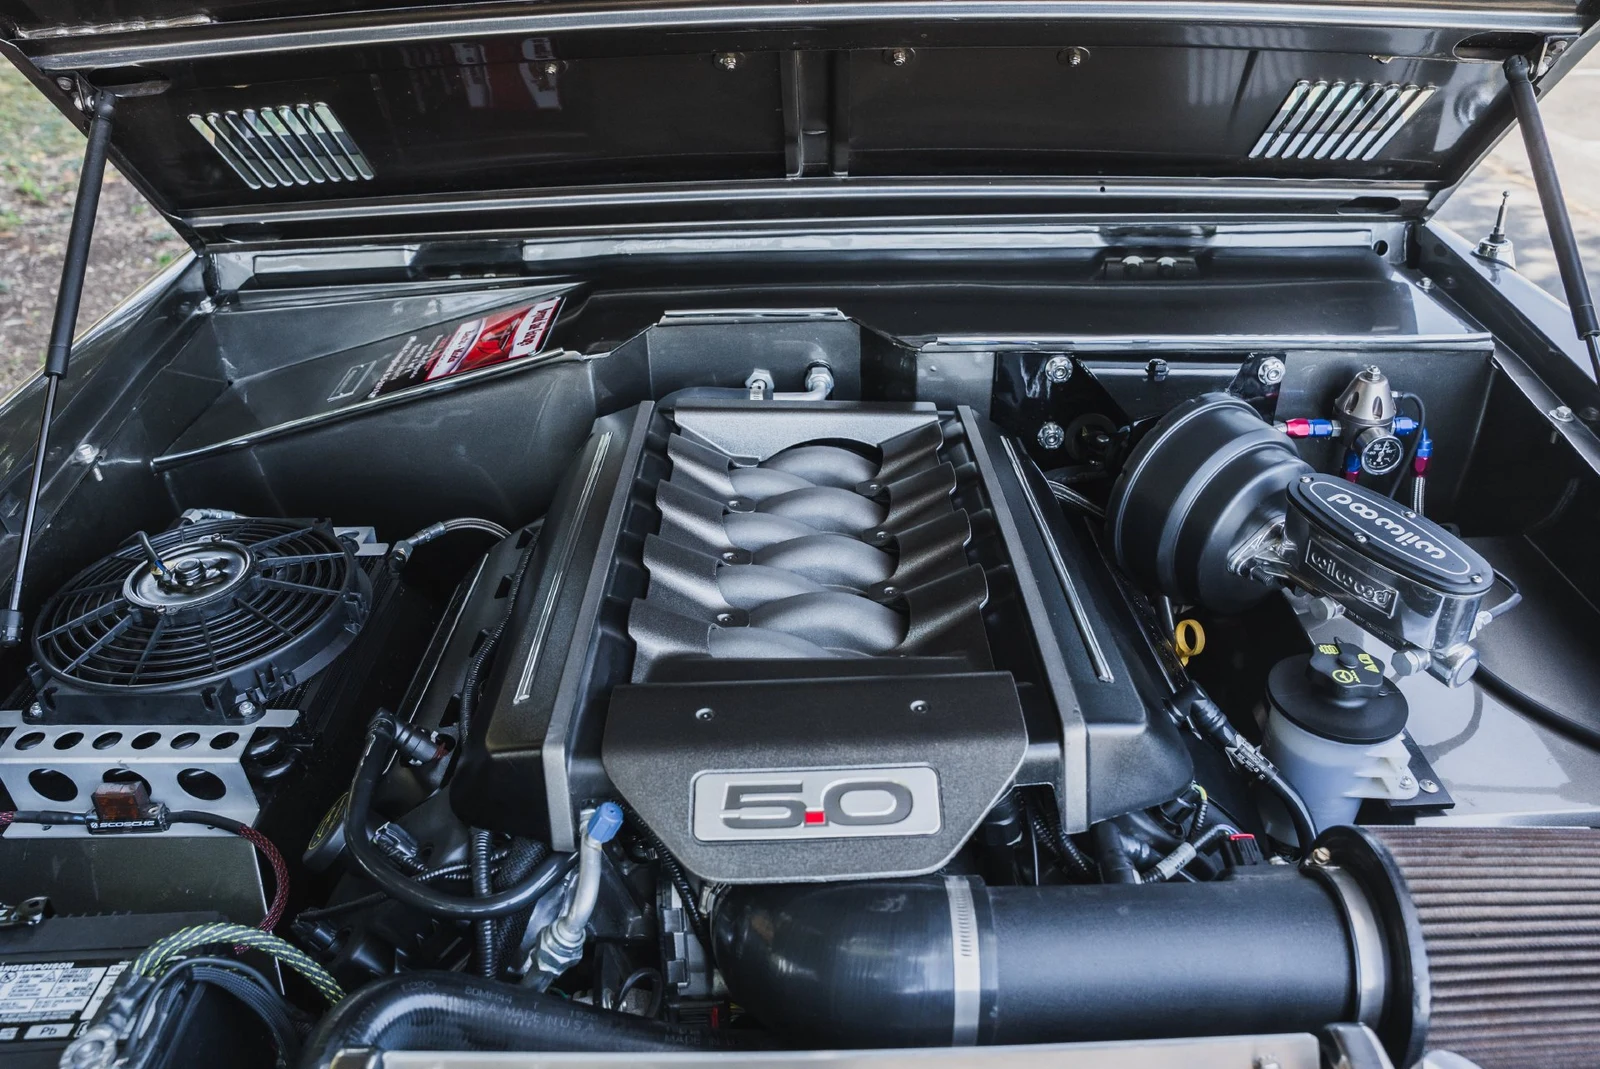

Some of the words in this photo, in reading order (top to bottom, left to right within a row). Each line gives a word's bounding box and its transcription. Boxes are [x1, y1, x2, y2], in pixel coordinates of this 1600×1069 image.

[1326, 492, 1447, 560] wilwood
[719, 777, 914, 830] 5.0
[100, 820, 155, 828] SCOSCHE
[40, 1026, 57, 1035] Pb
